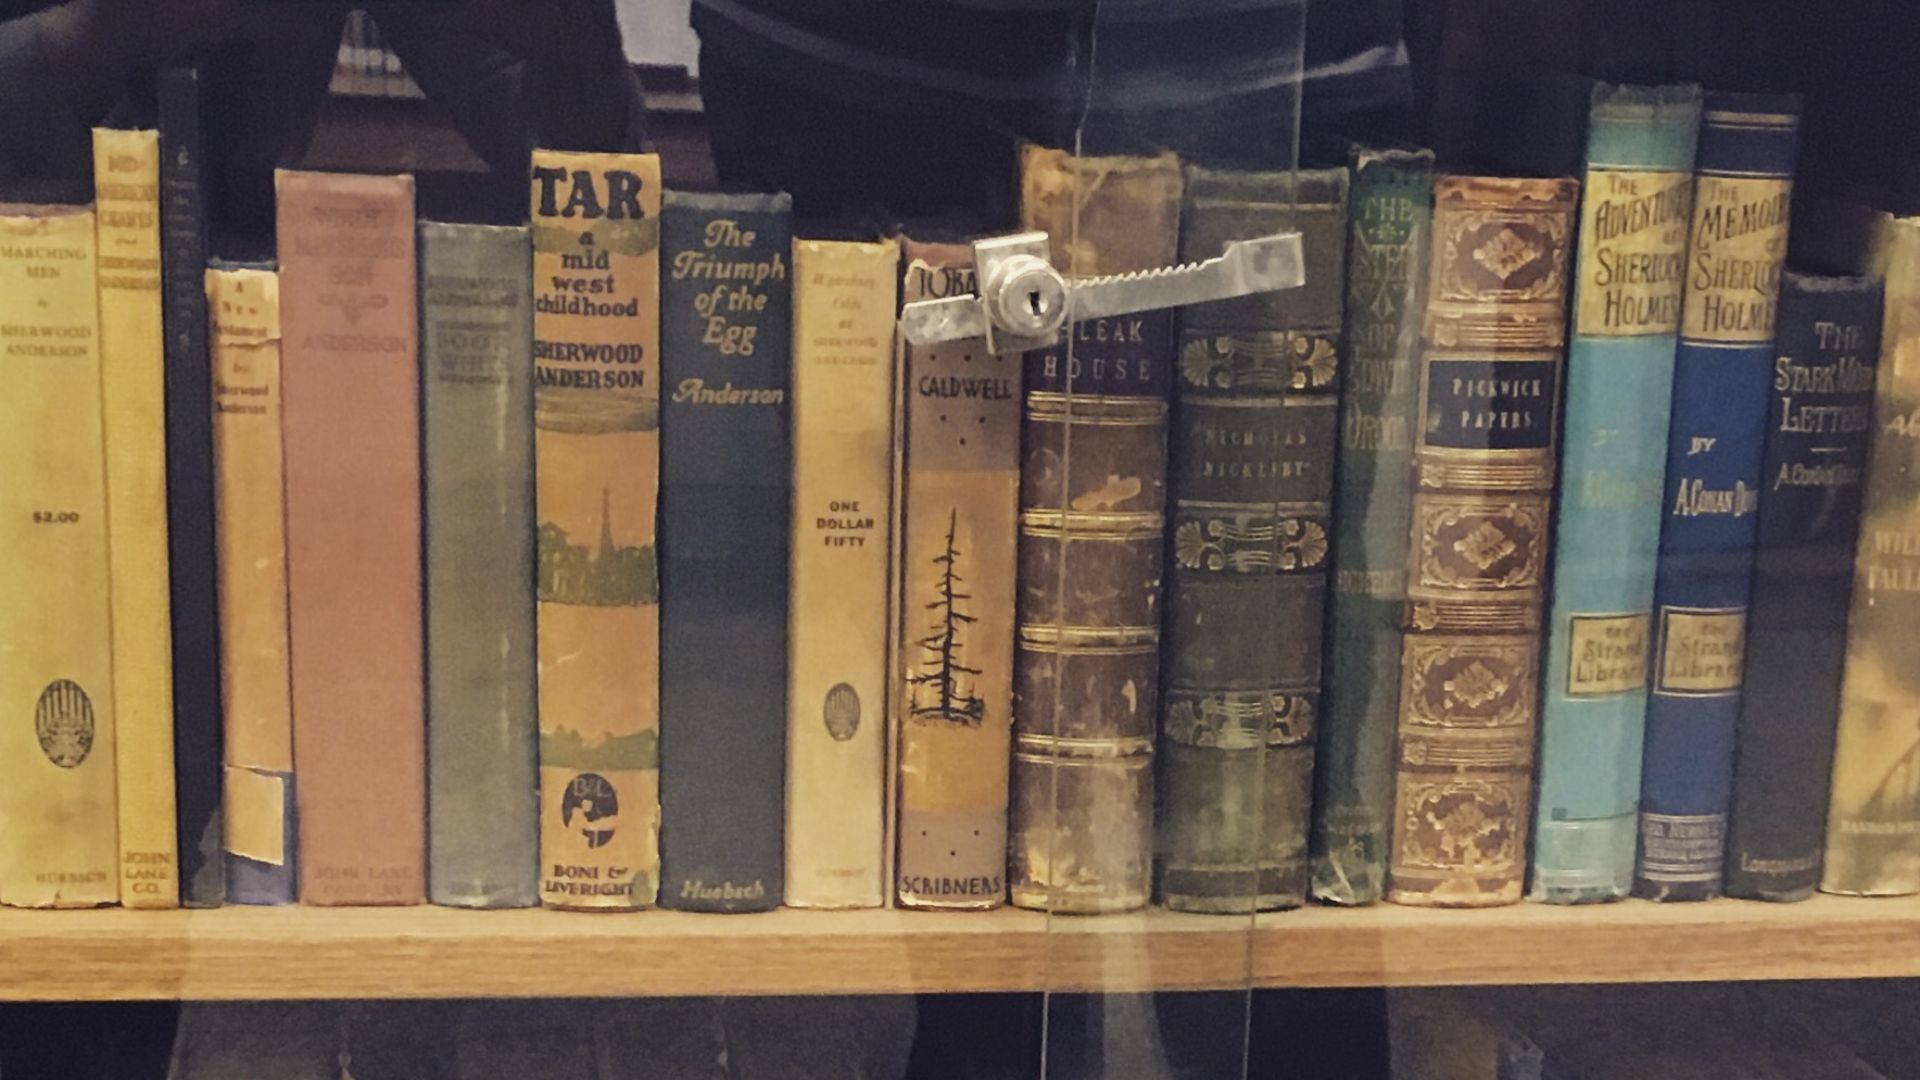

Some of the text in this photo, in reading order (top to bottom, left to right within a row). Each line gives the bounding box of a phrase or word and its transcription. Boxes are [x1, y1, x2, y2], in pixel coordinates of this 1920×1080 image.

[532, 166, 644, 220] TAR
[1607, 174, 1638, 196] THE
[578, 231, 594, 246] a
[704, 219, 756, 248] The
[562, 251, 611, 270] mid
[672, 250, 785, 285] Triumph
[26, 266, 60, 279] MEN
[552, 274, 615, 294] west
[536, 294, 639, 317] childhood
[694, 284, 768, 319] of the
[703, 315, 757, 356] Egg
[1062, 319, 1143, 343] LEAK
[6, 344, 88, 357] ANDERSON
[534, 341, 643, 364] SHERWOOD
[535, 366, 644, 390] ANDERSON
[1044, 356, 1151, 382] HOUSE
[672, 377, 785, 405] Anderson
[919, 374, 1012, 400] CALDWELL
[1452, 378, 1541, 398] PICKWICK
[1461, 410, 1532, 429] PAPERS
[829, 501, 860, 512] ONE
[816, 518, 875, 530] DOLLAR
[824, 536, 865, 548] FIFTY
[554, 864, 598, 879] BONI
[902, 876, 1000, 897] SCRIBNERS
